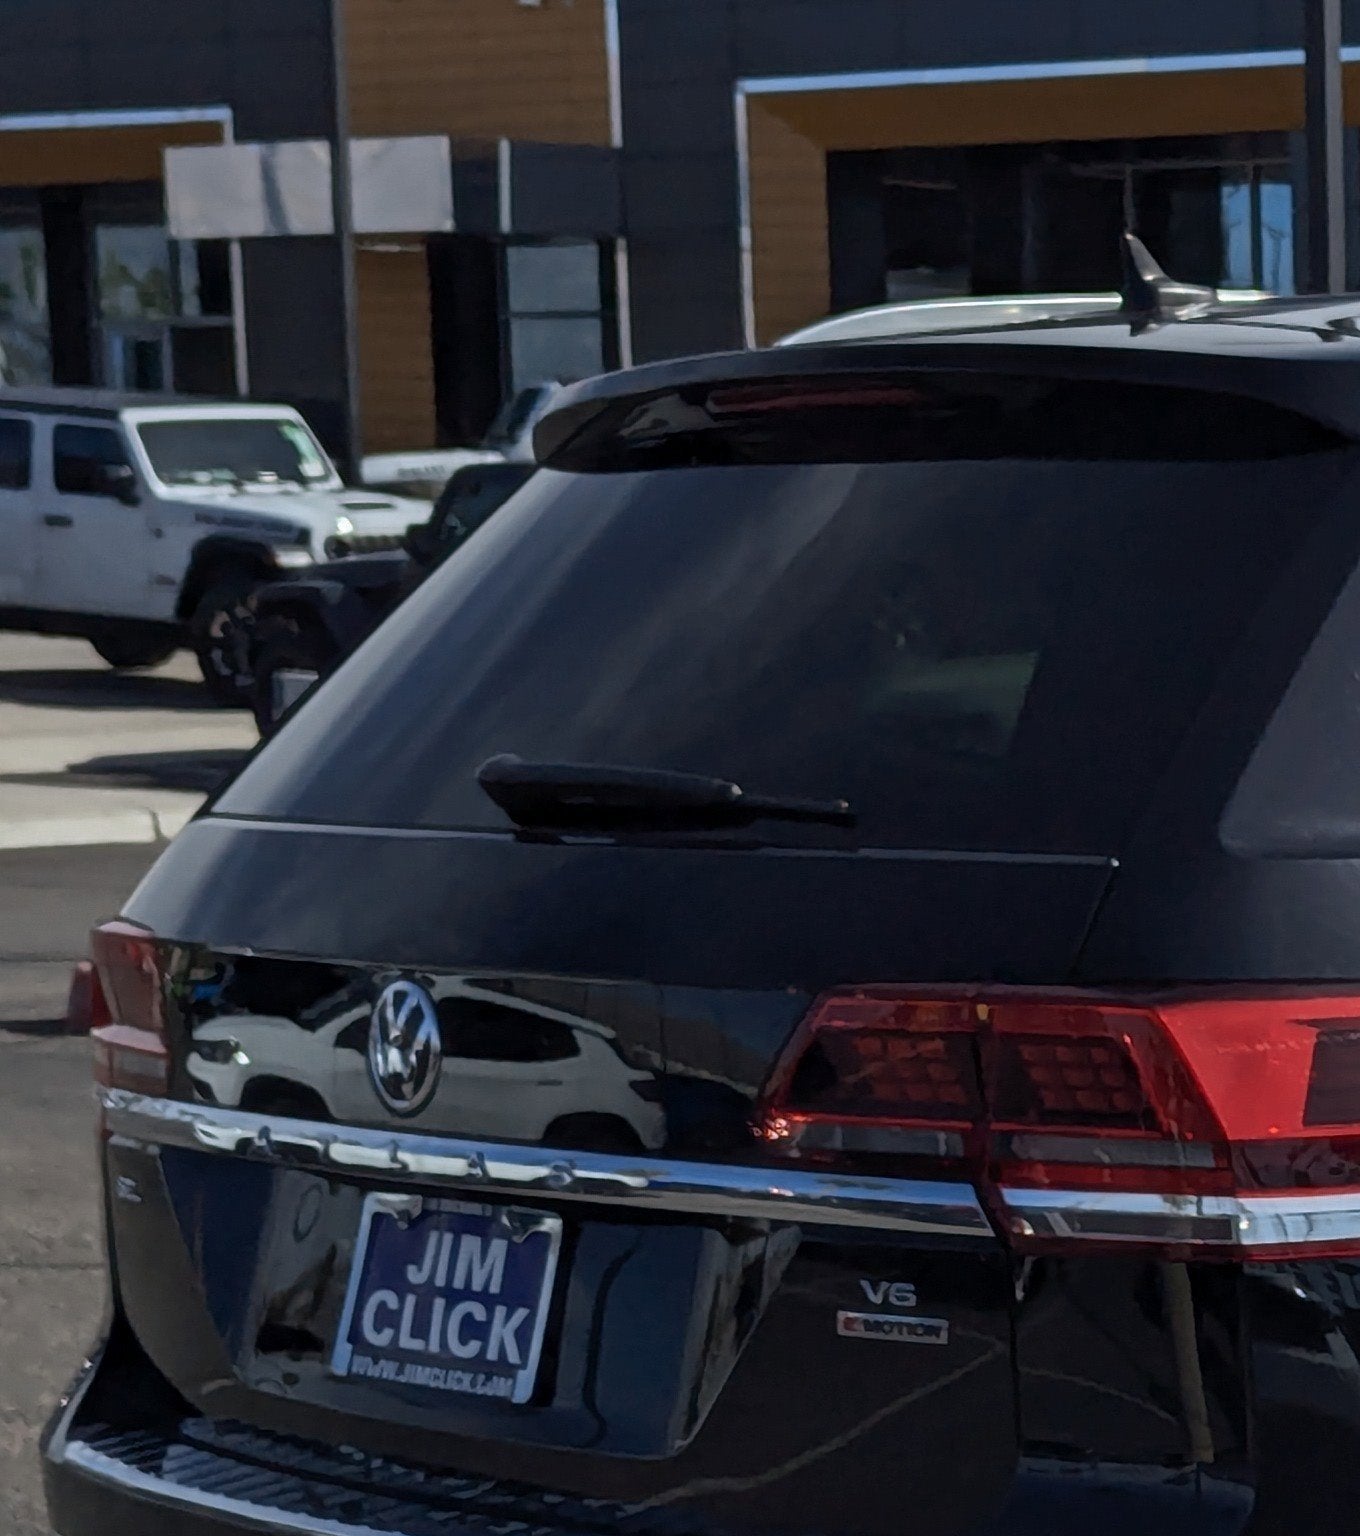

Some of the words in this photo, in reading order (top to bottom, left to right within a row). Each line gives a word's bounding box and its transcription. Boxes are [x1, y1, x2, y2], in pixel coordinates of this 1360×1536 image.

[407, 1230, 508, 1294] JIM
[860, 1280, 917, 1307] V6
[363, 1289, 530, 1365] CLICK
